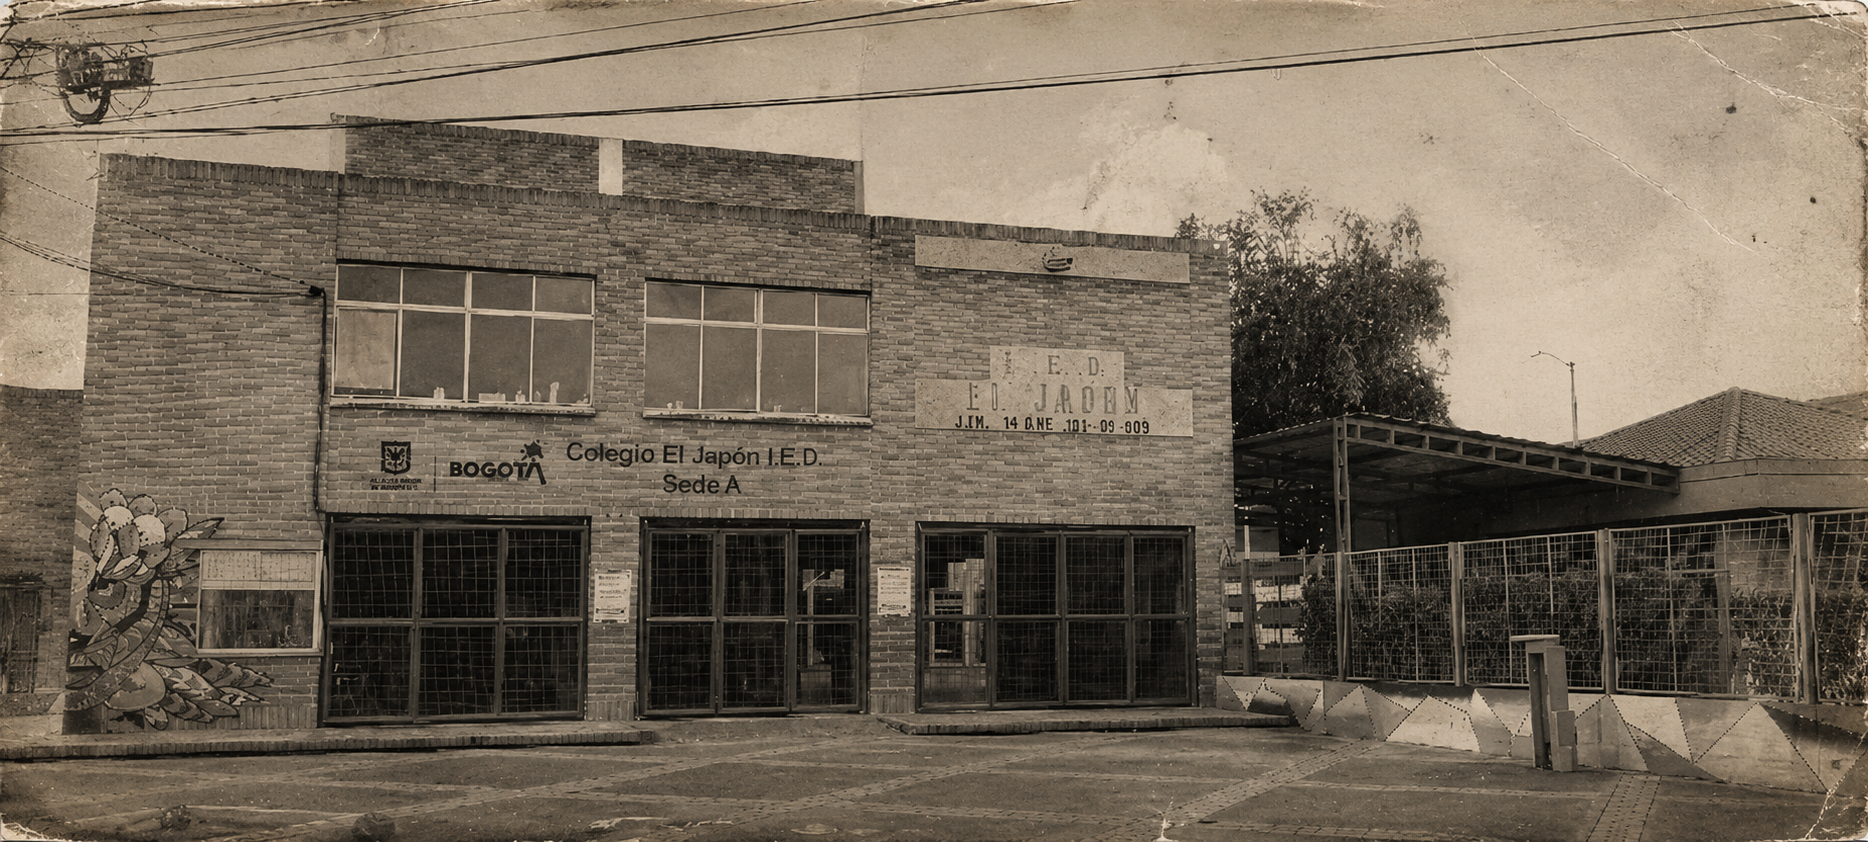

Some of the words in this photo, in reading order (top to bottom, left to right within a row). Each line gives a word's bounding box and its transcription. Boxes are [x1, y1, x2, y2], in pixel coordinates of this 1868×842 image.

[566, 442, 655, 468] Colegio
[662, 445, 684, 464] El
[692, 446, 760, 470] Japón
[768, 447, 823, 466] I.E.D.
[662, 474, 720, 494] Sede
[724, 474, 742, 494] A
